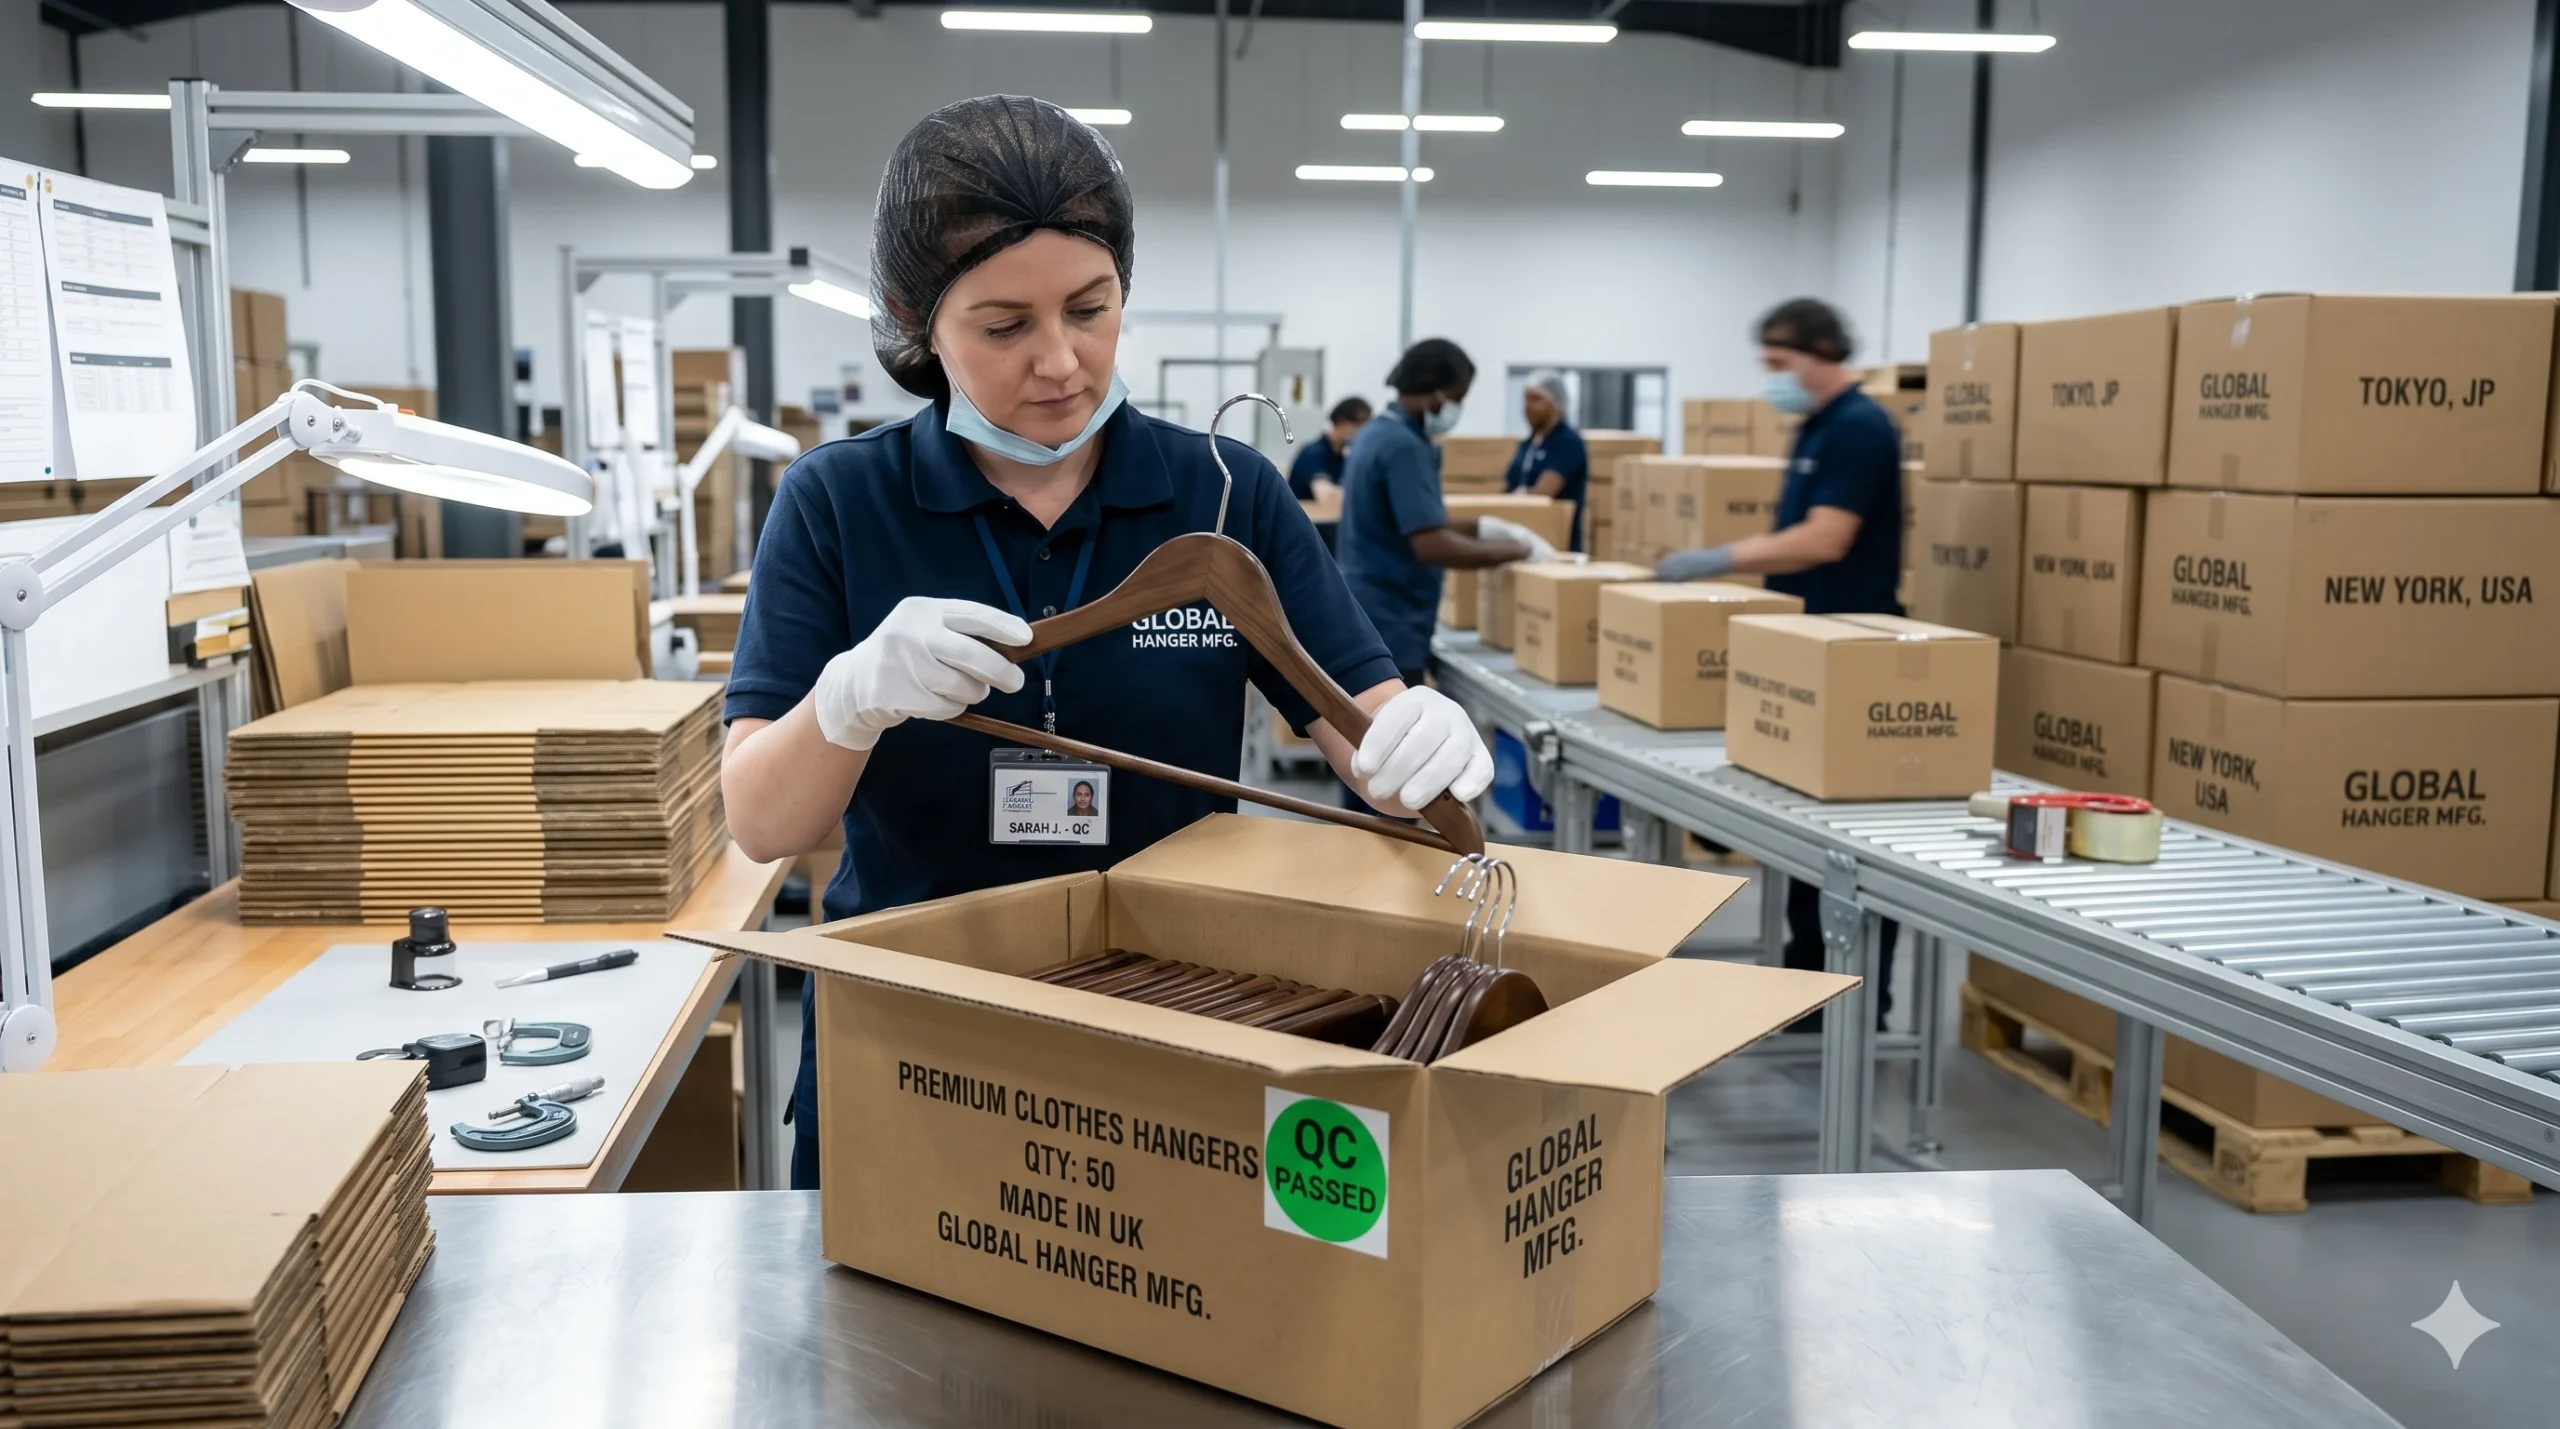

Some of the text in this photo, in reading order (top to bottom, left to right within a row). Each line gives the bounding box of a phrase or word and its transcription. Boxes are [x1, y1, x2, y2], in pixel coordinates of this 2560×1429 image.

[2101, 380, 2120, 408] JP
[2200, 373, 2271, 400] GLOBAL
[2359, 377, 2495, 411] TOKYO, JP
[2200, 403, 2270, 420] HANGER MFG.
[2173, 554, 2252, 592] GLOBAL
[2171, 587, 2252, 616] HANGER MFG.
[2325, 576, 2533, 608] NEW YORK, USA
[1131, 607, 1235, 630] GLOBAL
[1132, 633, 1238, 648] HANGER MFG.
[1868, 702, 1957, 723] GLOBAL
[1867, 724, 1958, 739] HANGER MFG.
[2033, 711, 2106, 754] GLOBAL
[2169, 737, 2260, 792] NEW YORK,
[2195, 779, 2229, 815] USA
[2344, 768, 2486, 802] GLOBAL
[1009, 822, 1049, 833] SARAH
[1052, 823, 1061, 834] J.
[1072, 823, 1090, 835] QC
[2342, 805, 2486, 828] HANGER MFG.
[899, 1060, 1259, 1179] PREMIUM CLOTHES HANGERS
[1294, 1117, 1357, 1170] QC
[1507, 1113, 1602, 1194] GLOBAL
[1024, 1140, 1115, 1192] QTY: 50
[1275, 1166, 1377, 1215] PASSED
[1505, 1156, 1602, 1243] HANGER
[1000, 1181, 1144, 1250] MADE IN UK
[938, 1210, 1211, 1320] GLOBAL HANGER MFG.
[1523, 1216, 1584, 1279] MFG.
